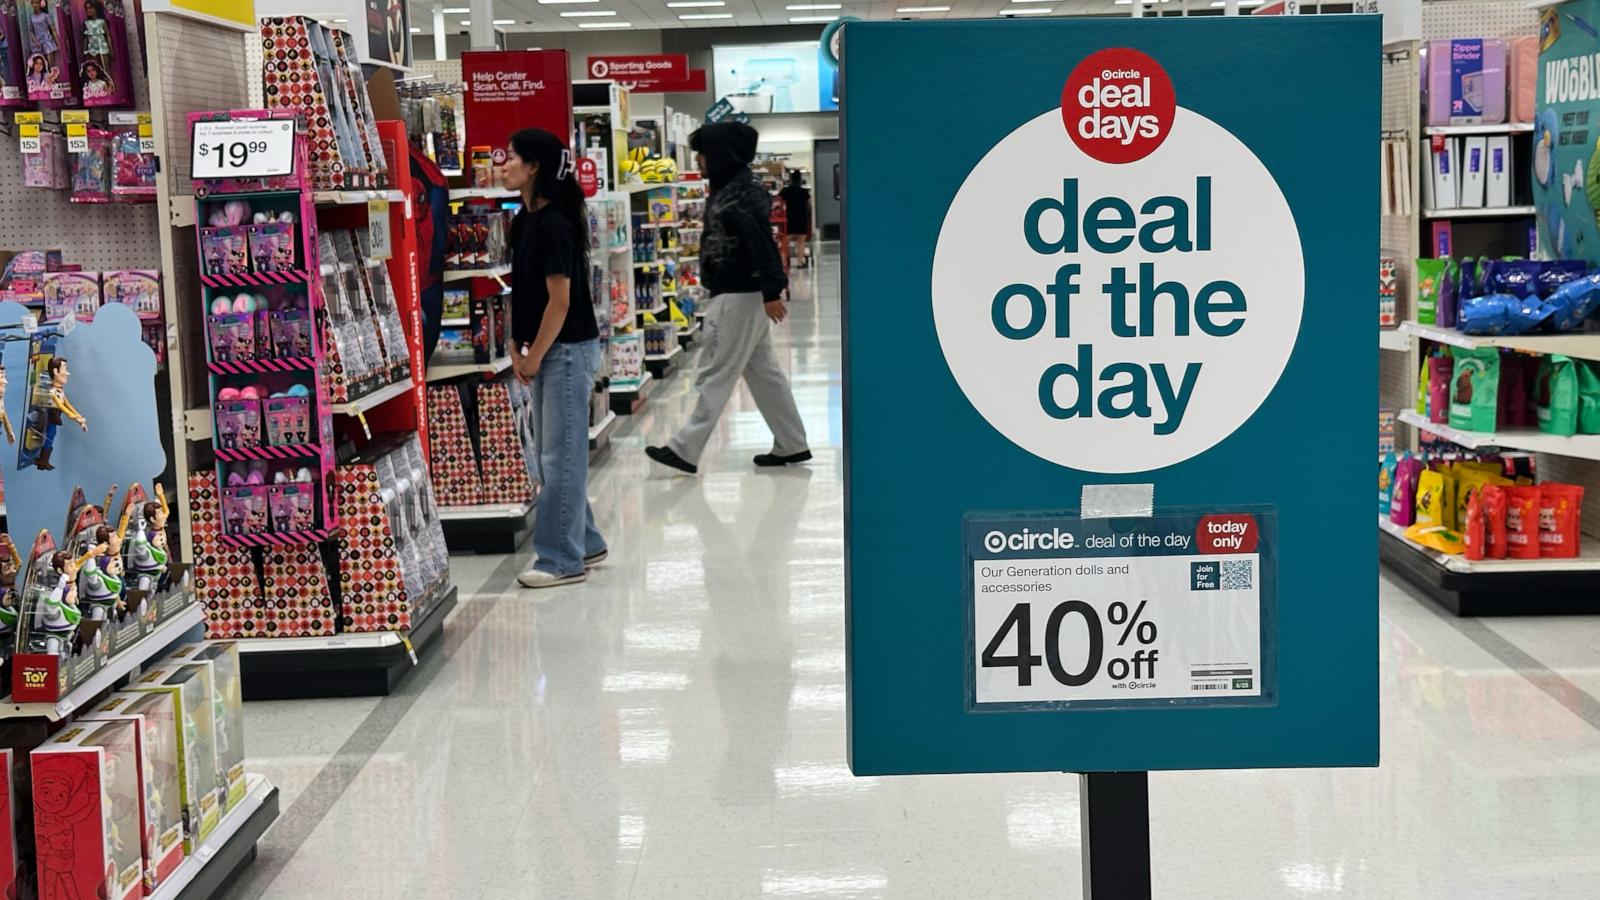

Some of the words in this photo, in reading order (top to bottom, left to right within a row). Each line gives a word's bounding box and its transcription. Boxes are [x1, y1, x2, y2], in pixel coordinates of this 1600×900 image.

[1453, 44, 1481, 52] Zipper
[1453, 52, 1481, 60] Binder
[609, 62, 645, 72] Sporting
[645, 60, 673, 70] Goods
[472, 72, 494, 82] Help
[496, 71, 528, 81] Center
[1112, 69, 1140, 79] circle
[473, 81, 499, 91] Scan.
[501, 81, 521, 90] Call.
[522, 80, 546, 90] Find.
[1078, 77, 1150, 108] deal
[1078, 108, 1160, 146] days
[1024, 176, 1211, 254] deal
[409, 251, 418, 307] Listen,
[991, 264, 1080, 338] of
[1102, 263, 1247, 337] the
[413, 310, 421, 345] play
[416, 349, 424, 382] and
[1039, 345, 1201, 435] day
[1207, 520, 1248, 535] today
[1008, 527, 1075, 550] circle
[1085, 534, 1116, 549] deal
[1119, 533, 1134, 548] of
[1137, 533, 1161, 547] the
[1164, 532, 1191, 549] day
[1212, 534, 1243, 550] only
[981, 567, 1004, 577] Our
[1006, 565, 1072, 577] Generation
[1075, 564, 1104, 576] dolls
[1106, 564, 1129, 575] and
[1196, 565, 1214, 573] Join
[981, 581, 1052, 593] accessories
[1196, 581, 1215, 589] Free
[1107, 650, 1158, 680] off
[22, 671, 49, 683] TOY
